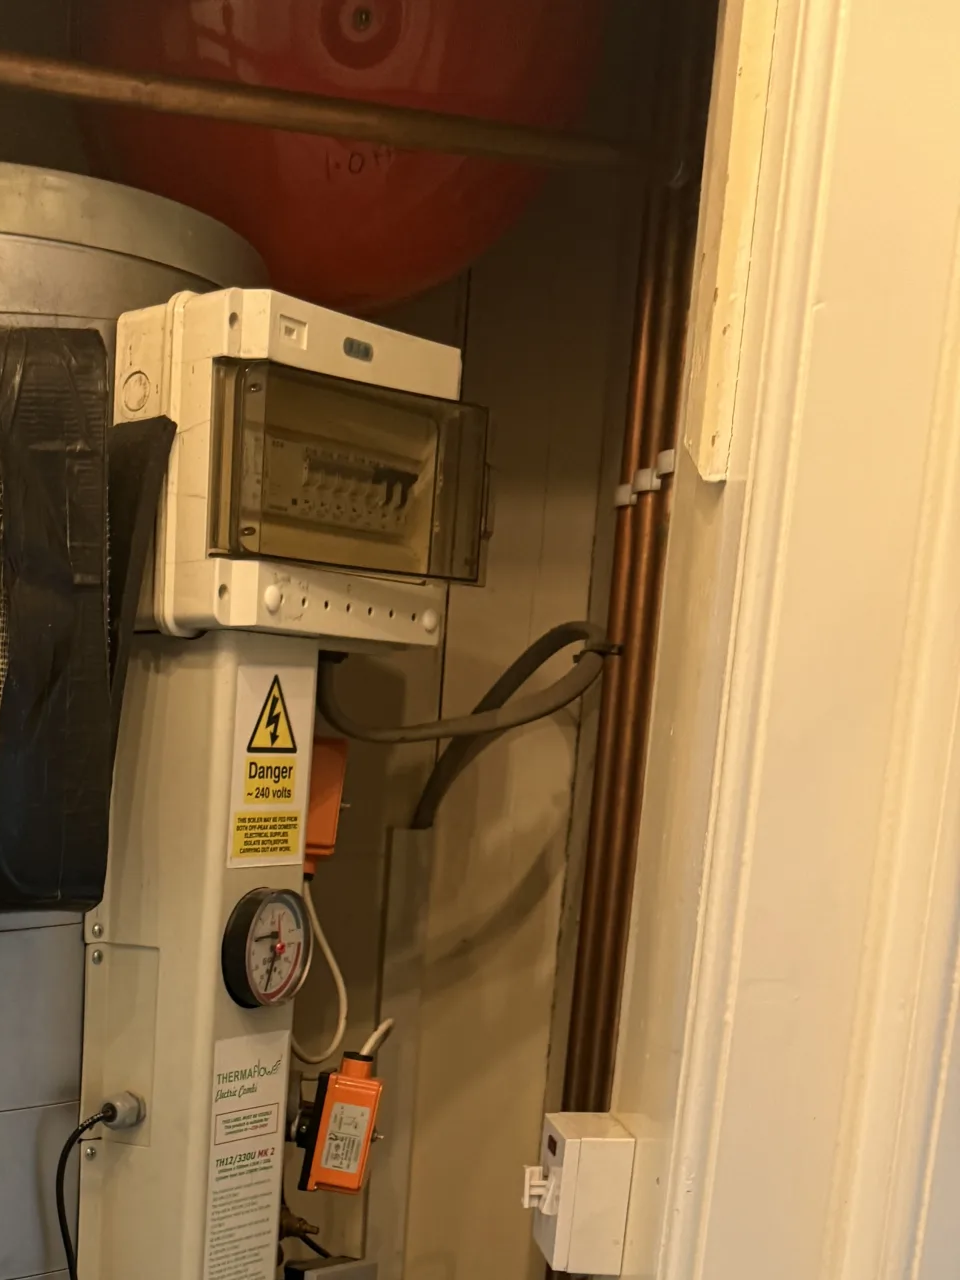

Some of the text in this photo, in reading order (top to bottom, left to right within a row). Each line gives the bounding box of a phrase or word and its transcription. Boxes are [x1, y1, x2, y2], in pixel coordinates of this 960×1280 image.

[248, 762, 293, 784] Danger
[254, 788, 271, 799] 240
[272, 787, 291, 799] volts
[215, 1089, 238, 1102] Electric
[216, 1147, 275, 1167] TH12/330U MK 2
